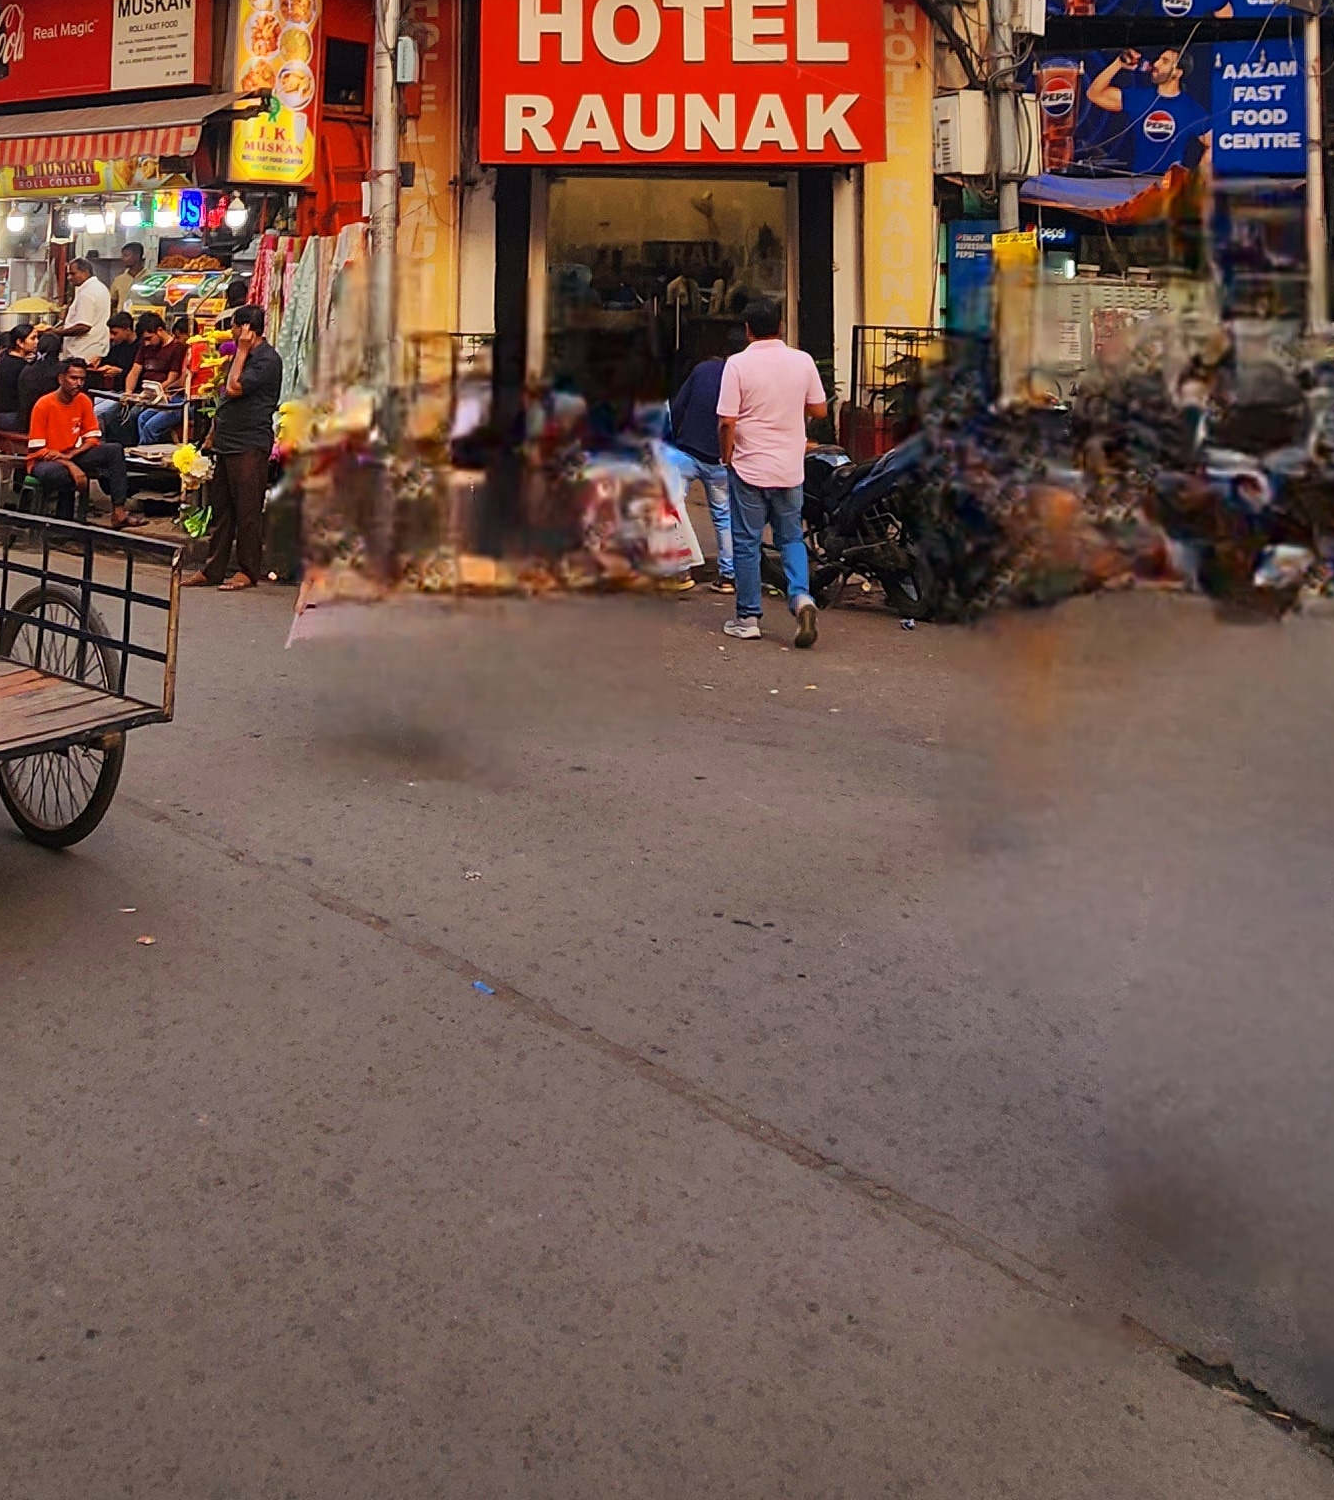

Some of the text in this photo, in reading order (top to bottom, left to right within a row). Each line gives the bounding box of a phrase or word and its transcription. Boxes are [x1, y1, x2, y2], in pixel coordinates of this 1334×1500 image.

[32, 20, 95, 40] Real Magic
[128, 20, 179, 33] ROLL FAST FOOD
[1221, 60, 1298, 80] AAZAM
[1041, 92, 1073, 102] PEPSI
[1233, 84, 1286, 102] FAST
[504, 93, 863, 153] RAUNAK
[1145, 120, 1174, 131] PEPSI
[1231, 109, 1288, 126] FOOD
[244, 141, 304, 155] MUSKAN
[1218, 132, 1302, 150] CENTRE
[880, 1, 916, 327] HOTEL RAUNA
[18, 176, 93, 189] ROLL CORNER
[1038, 227, 1067, 241] pepsi
